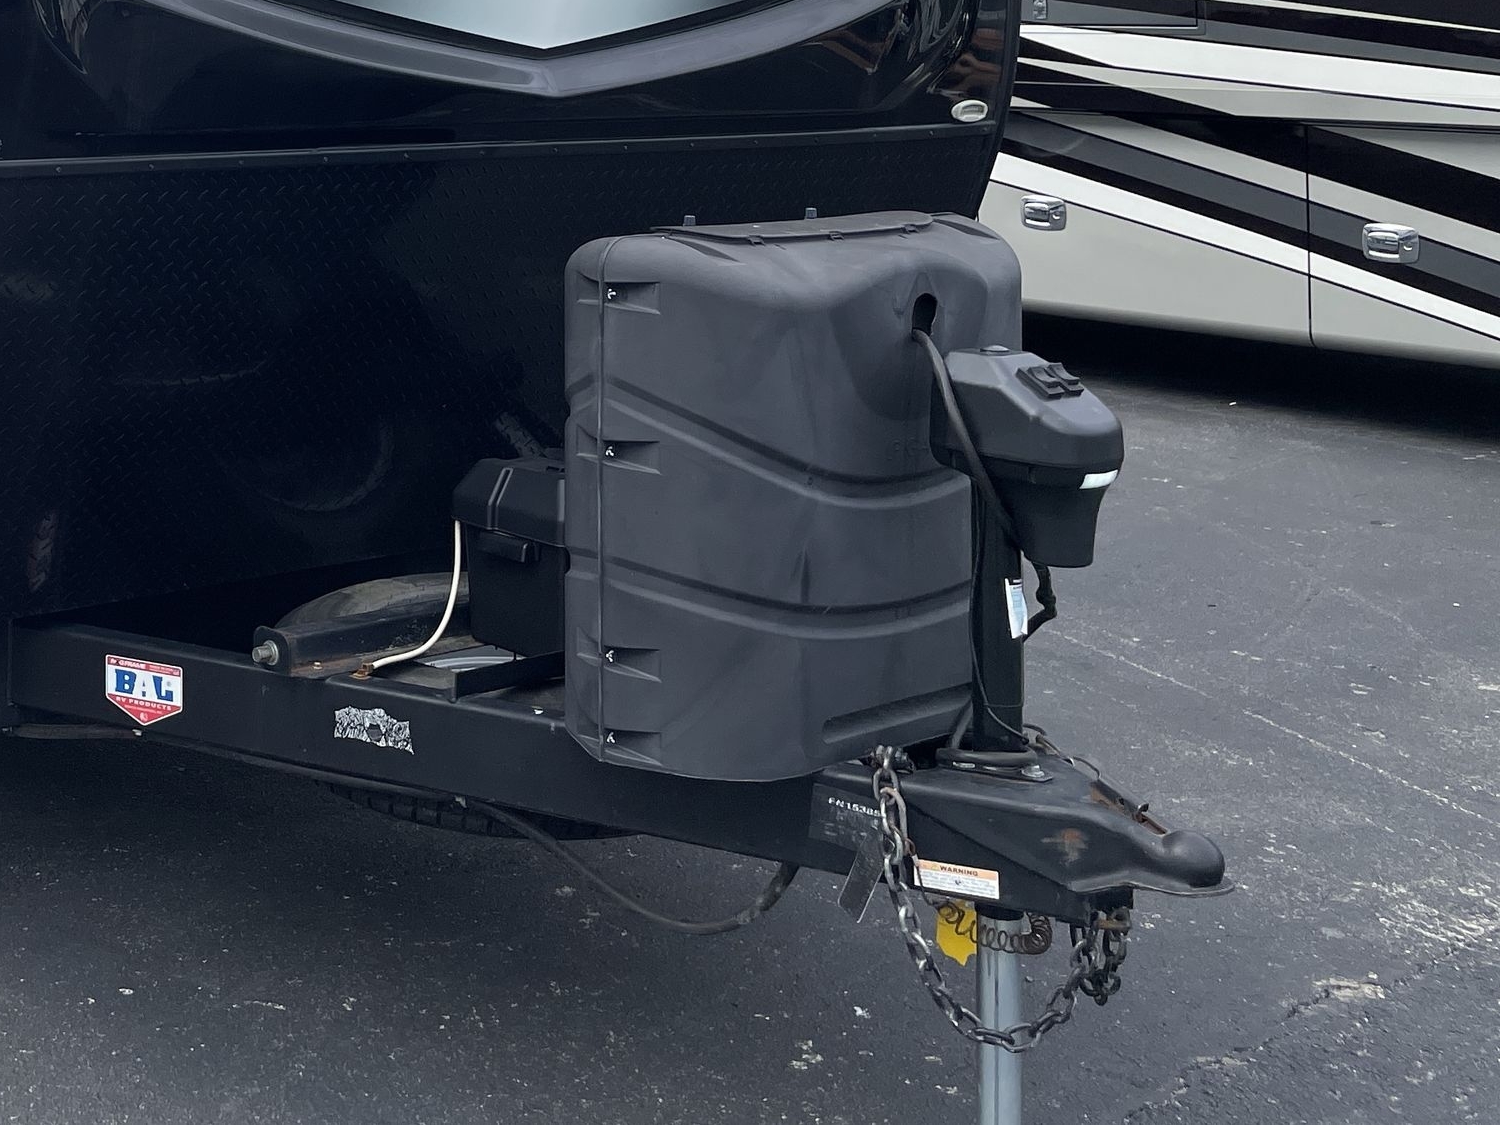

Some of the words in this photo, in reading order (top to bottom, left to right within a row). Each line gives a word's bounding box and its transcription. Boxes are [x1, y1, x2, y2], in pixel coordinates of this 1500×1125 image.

[114, 668, 174, 702] BAL
[128, 698, 172, 711] PRODUCTS
[940, 865, 979, 877] WARNING
